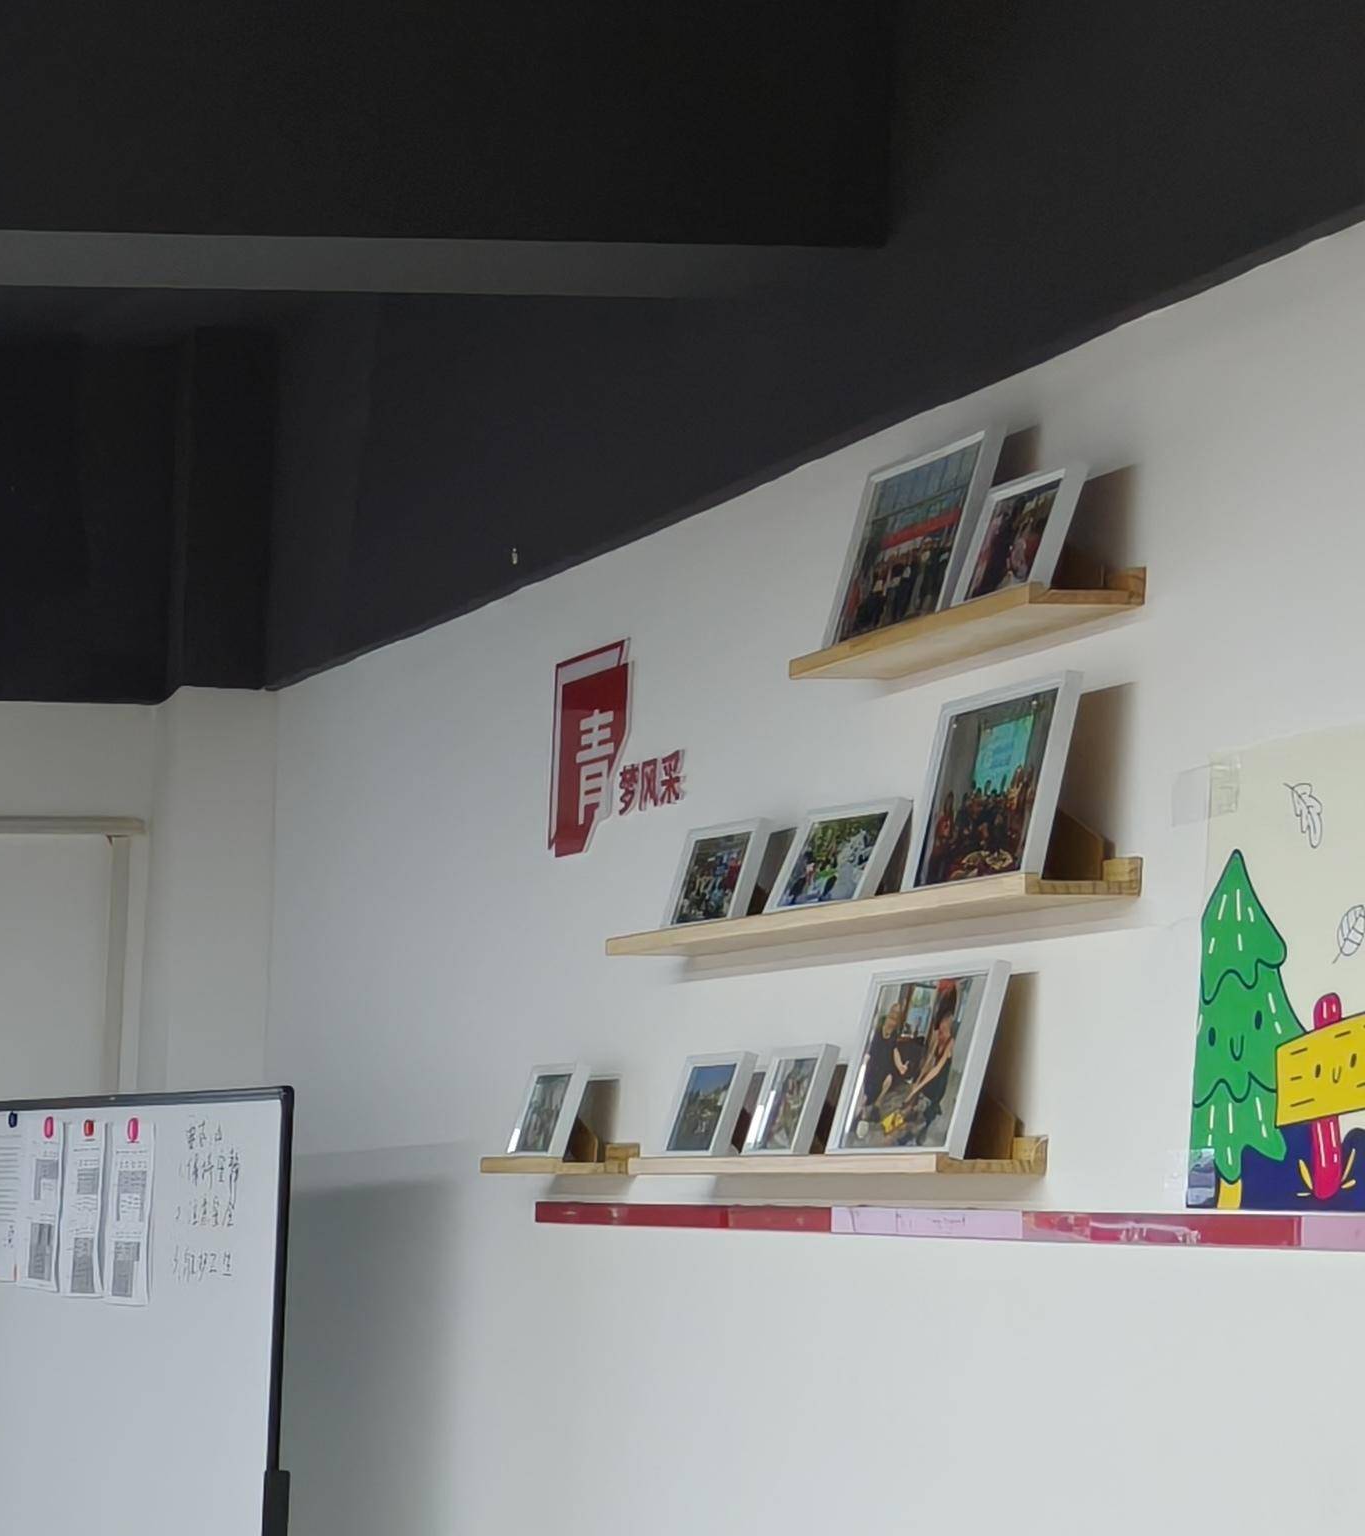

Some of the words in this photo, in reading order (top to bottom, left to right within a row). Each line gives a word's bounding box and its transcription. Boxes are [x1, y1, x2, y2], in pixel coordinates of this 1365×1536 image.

[576, 709, 614, 825] 青
[619, 750, 680, 815] 梦风采
